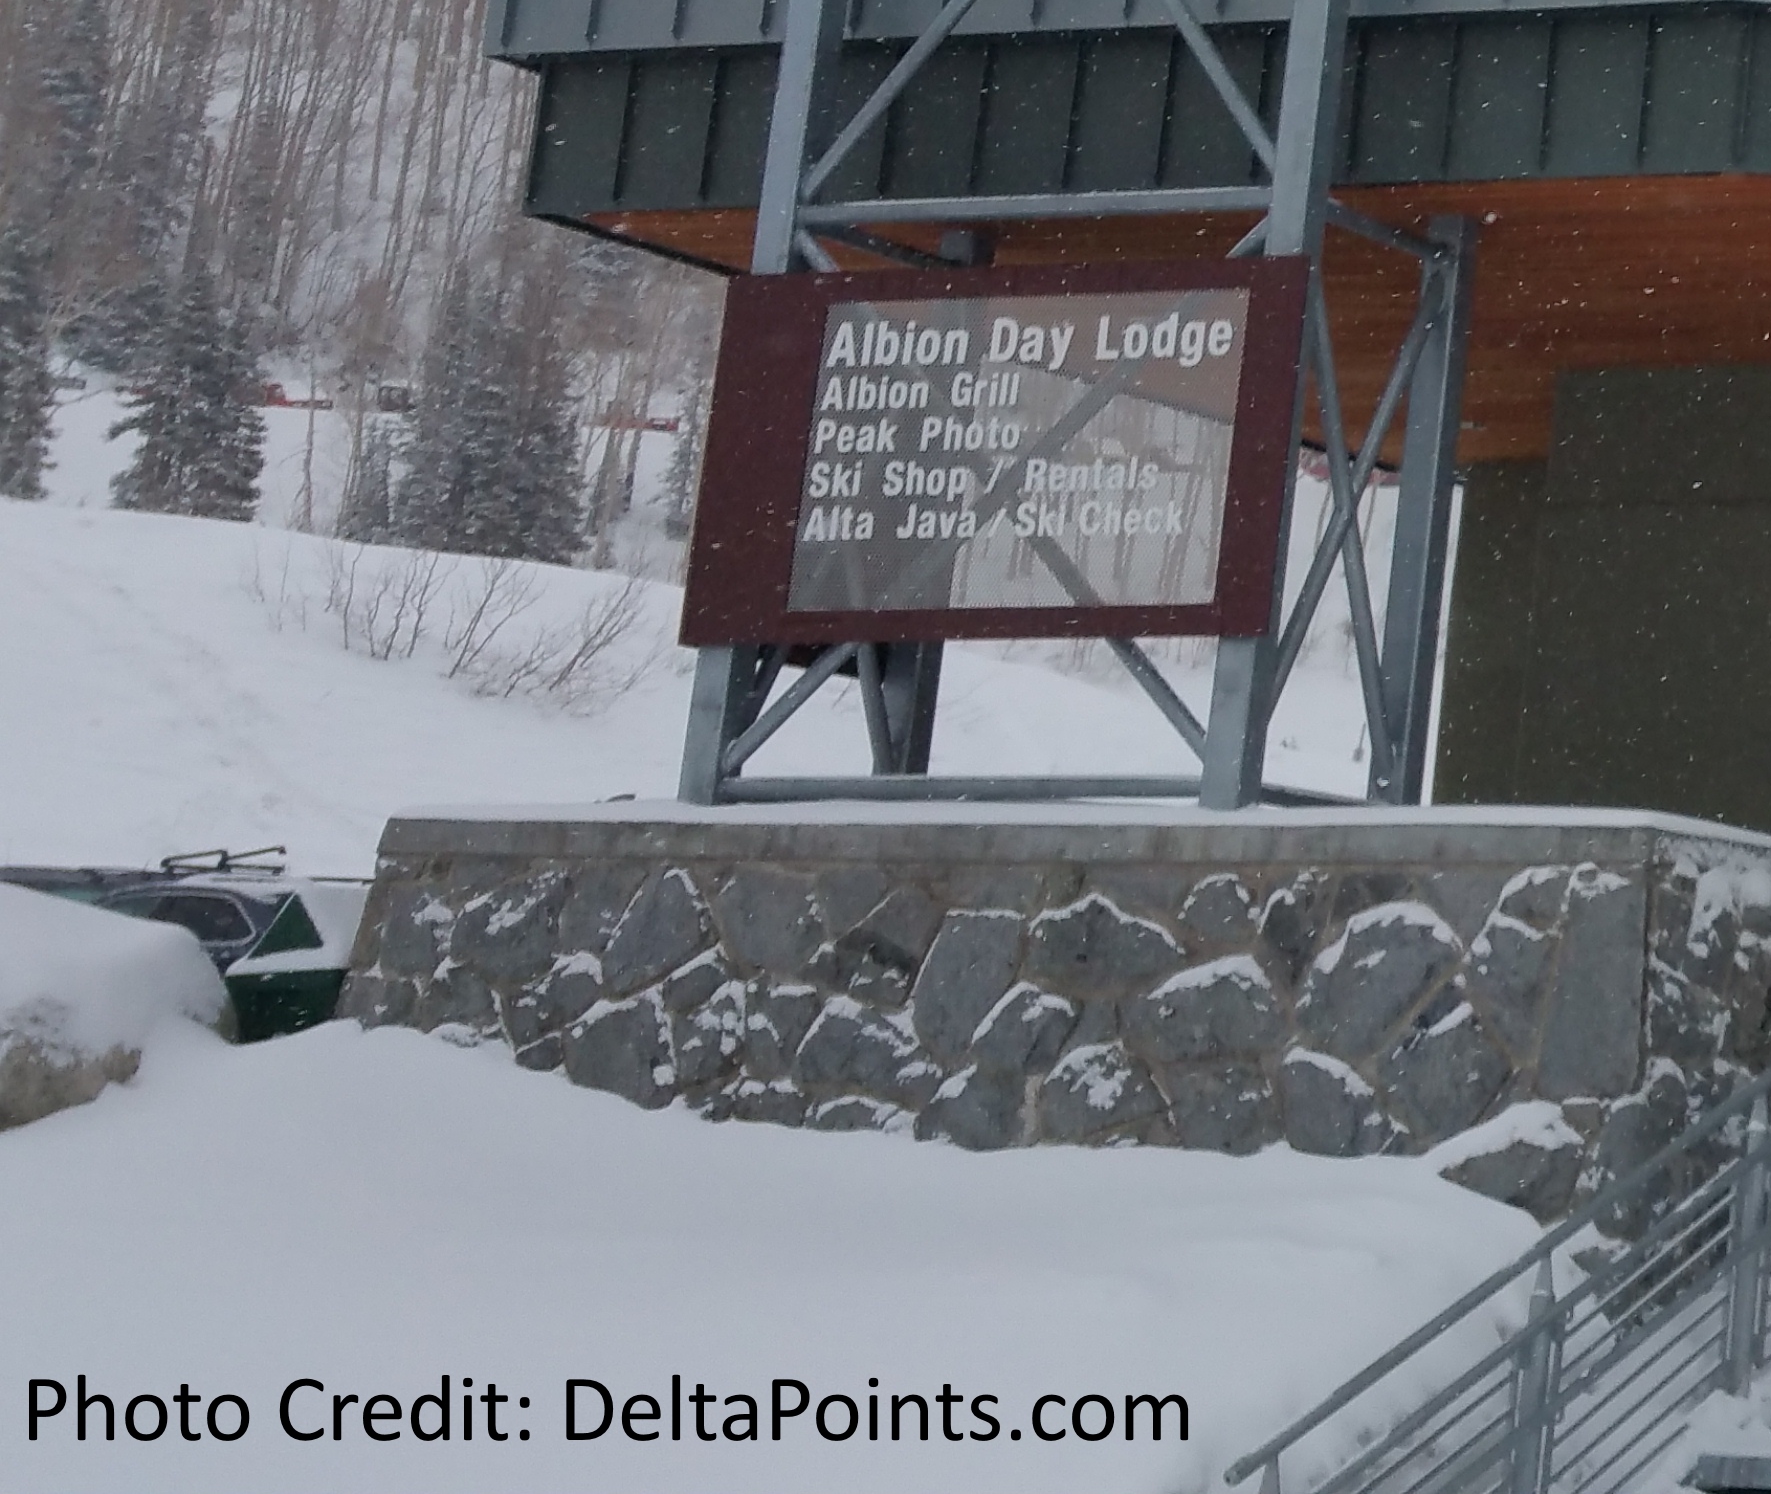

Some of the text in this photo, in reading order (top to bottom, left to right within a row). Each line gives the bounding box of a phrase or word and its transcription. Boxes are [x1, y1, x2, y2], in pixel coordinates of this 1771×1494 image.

[826, 312, 1234, 369] Albion Day Lodge
[819, 371, 1020, 411] Albion Grill
[813, 416, 1020, 453] Peak Photo
[808, 461, 863, 498] Ski
[882, 460, 968, 501] Shop
[1024, 455, 1159, 492] Rentals
[803, 507, 874, 541] Alta
[896, 504, 977, 539] Java
[1014, 502, 1068, 538] Ski
[1078, 504, 1184, 536] Check
